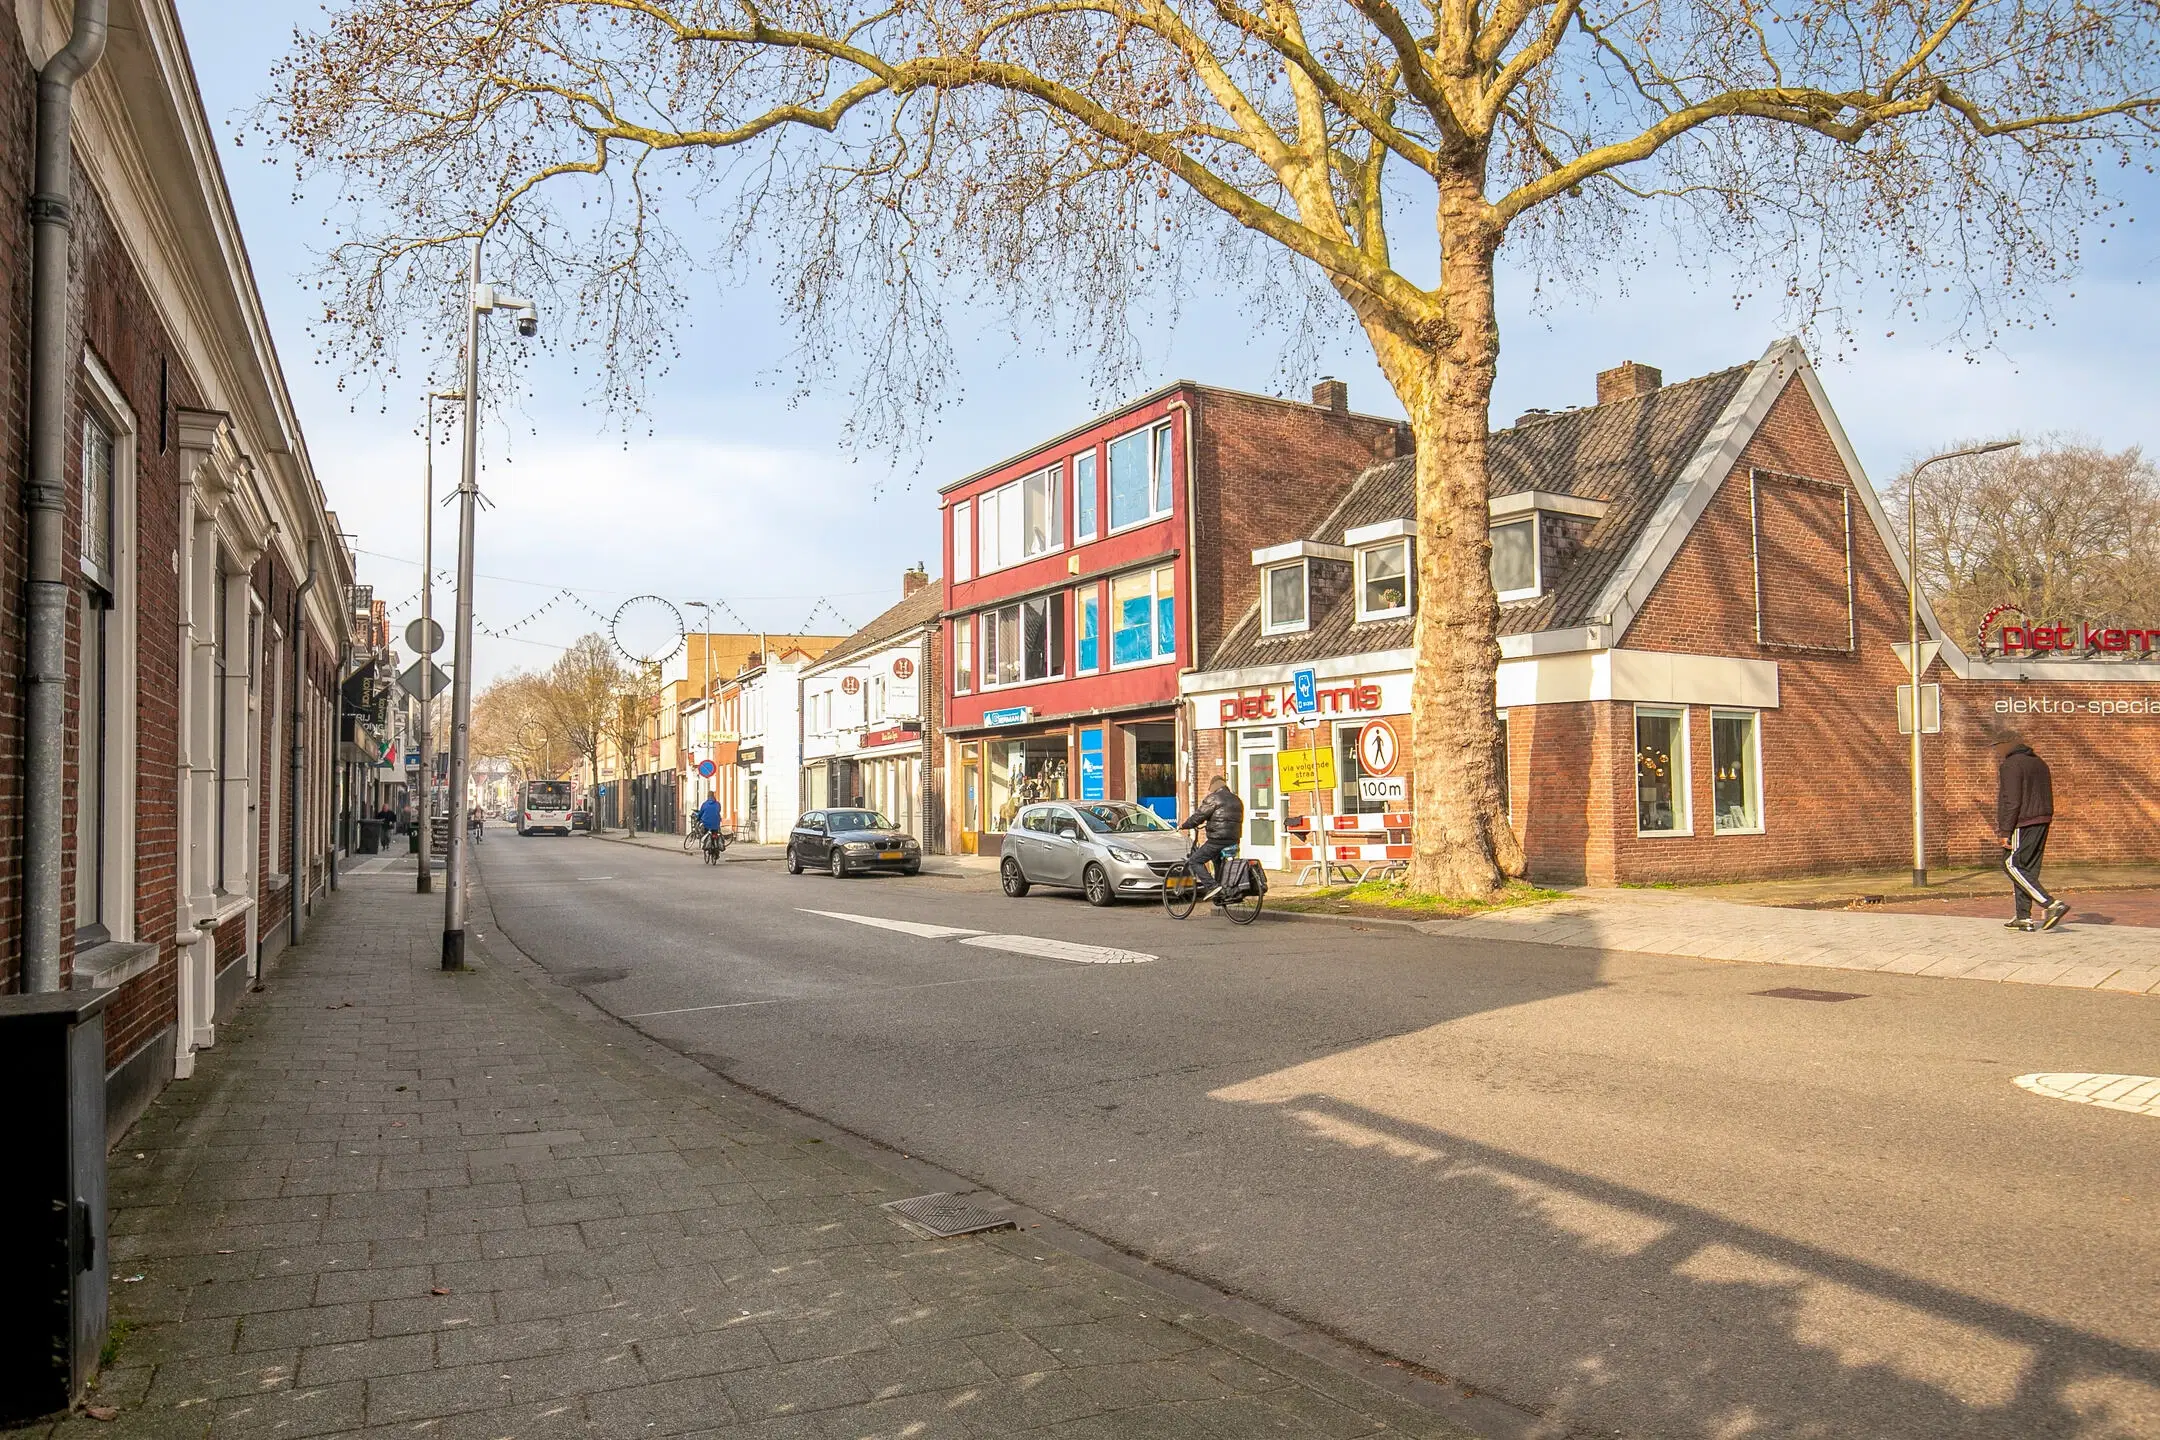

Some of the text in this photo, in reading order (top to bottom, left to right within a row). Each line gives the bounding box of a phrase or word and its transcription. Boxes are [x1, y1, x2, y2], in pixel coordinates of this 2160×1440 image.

[2003, 619, 2075, 655] piet
[1220, 678, 1381, 726] piet knnis
